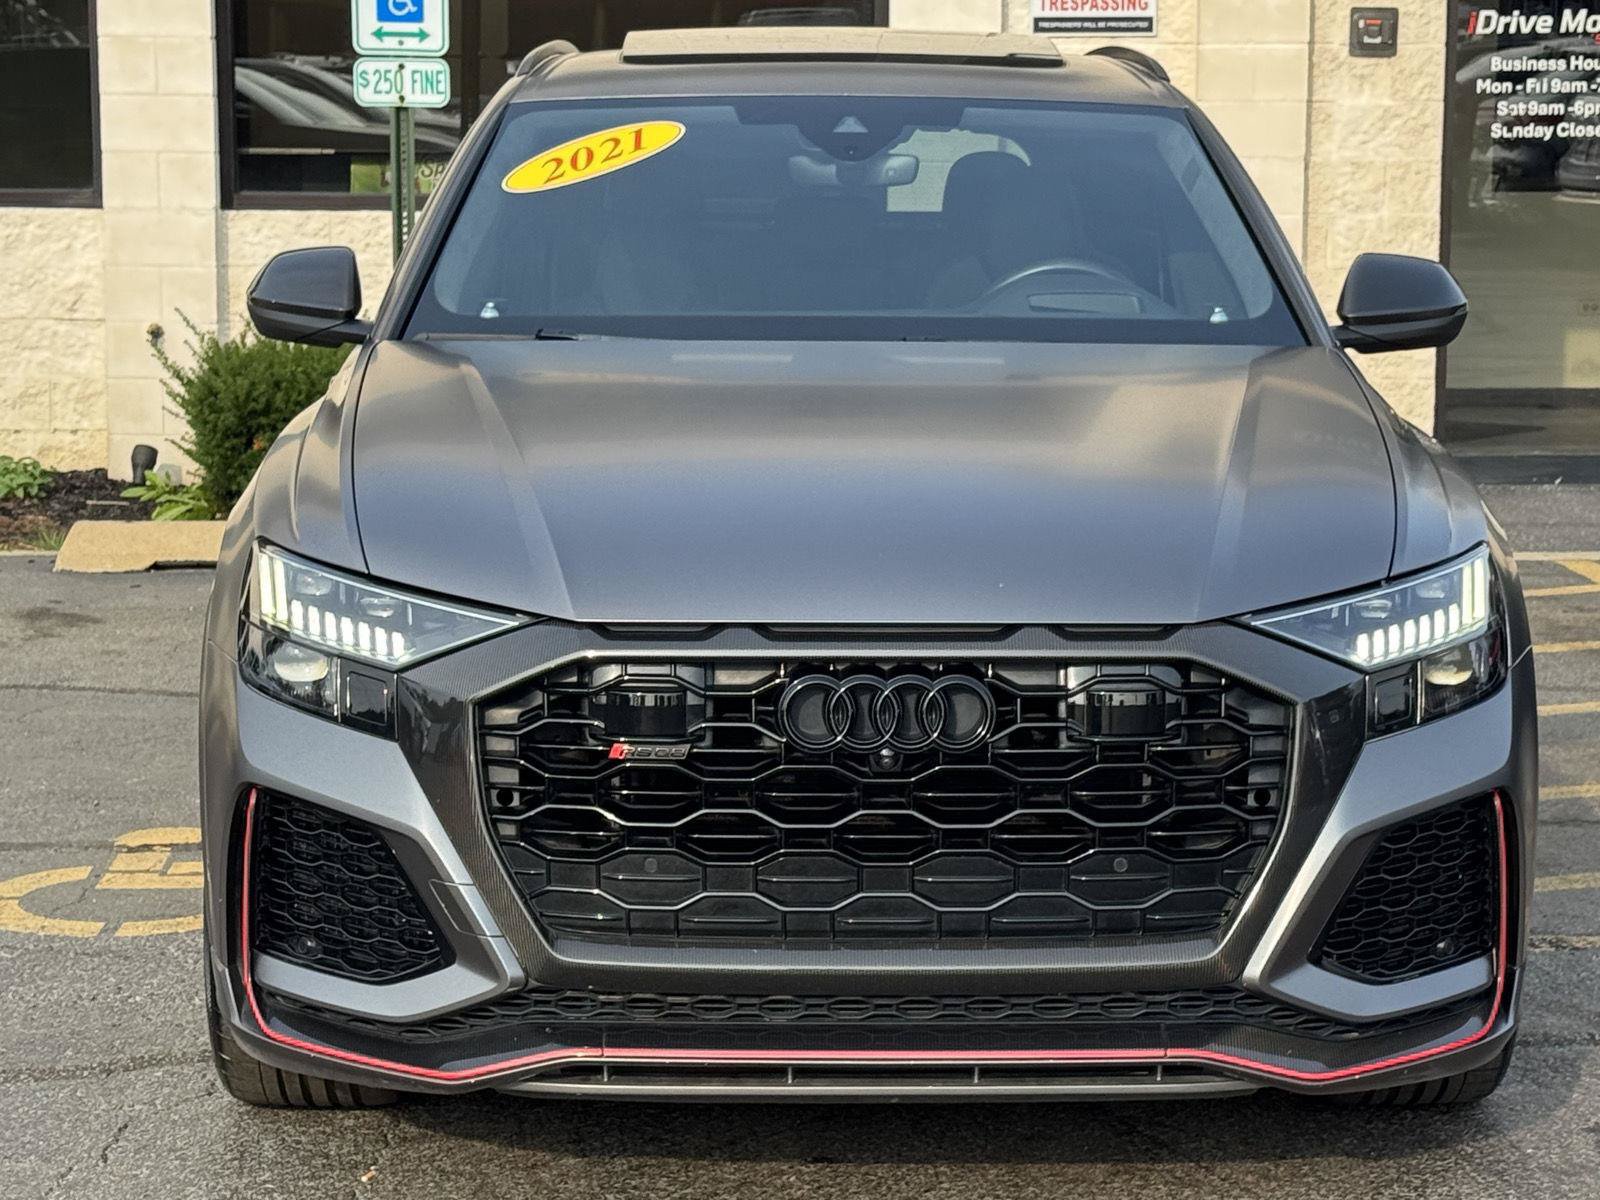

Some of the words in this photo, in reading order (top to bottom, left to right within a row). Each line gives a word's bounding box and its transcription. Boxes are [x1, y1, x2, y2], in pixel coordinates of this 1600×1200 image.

[1041, 0, 1148, 11] TRESPASSING
[1467, 9, 1554, 35] iDrive
[1490, 56, 1567, 72] Business
[359, 69, 404, 95] $250
[411, 70, 445, 95] FINE
[1476, 78, 1513, 94] Mon
[1550, 77, 1588, 94] 9am
[1527, 100, 1565, 116] 9am
[541, 128, 648, 184] 2021
